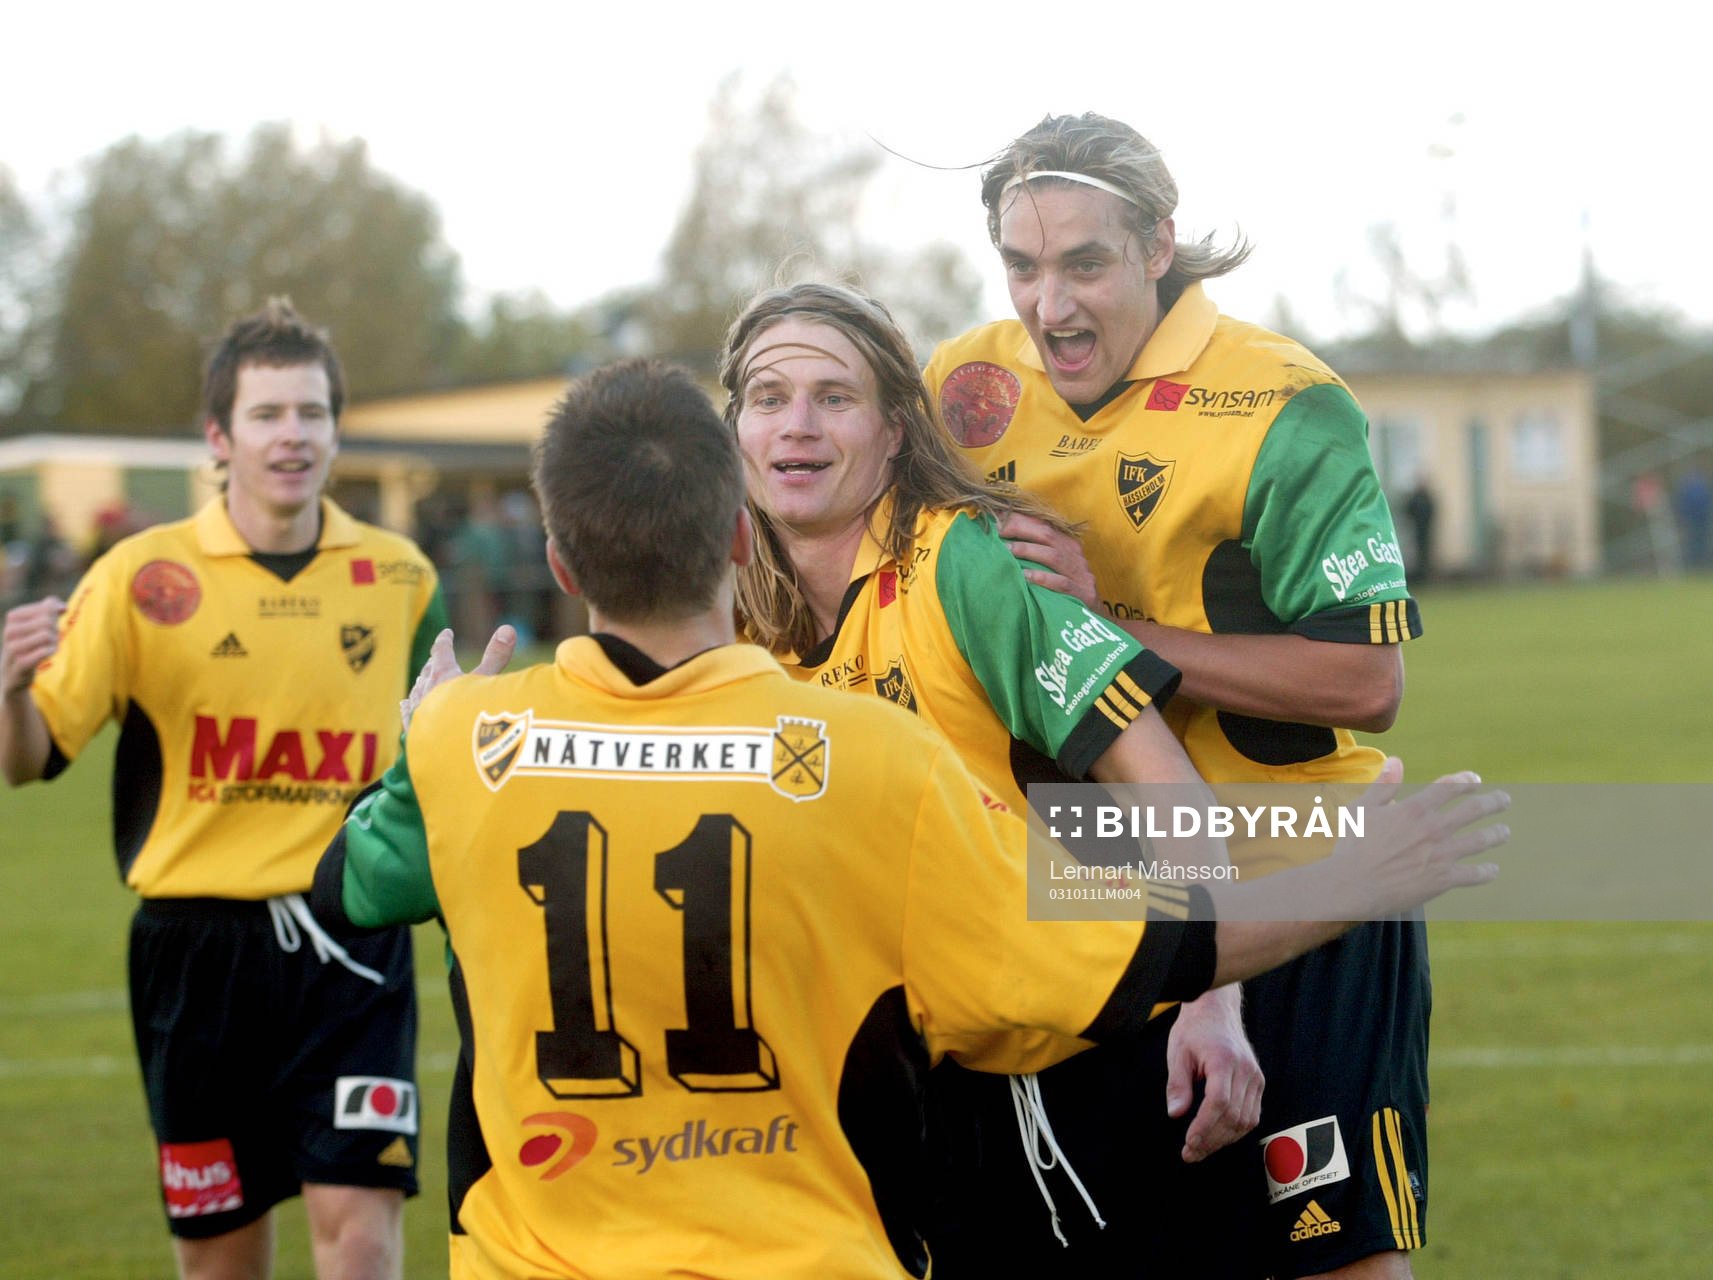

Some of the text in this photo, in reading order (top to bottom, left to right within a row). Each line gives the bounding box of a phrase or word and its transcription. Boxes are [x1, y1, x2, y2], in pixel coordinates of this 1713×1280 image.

[1057, 434, 1103, 451] BARE
[1123, 464, 1149, 483] IFK
[1322, 552, 1369, 602] Skea
[820, 654, 865, 688] REKO
[1035, 607, 1122, 709] Skea Gård
[1095, 640, 1129, 676] lantbruk
[533, 733, 762, 770] NÄTVERKET
[517, 810, 781, 1100] 11
[612, 1114, 800, 1175] sydkraft
[1302, 1171, 1338, 1187] OFFSET
[1290, 1219, 1341, 1242] adidas
